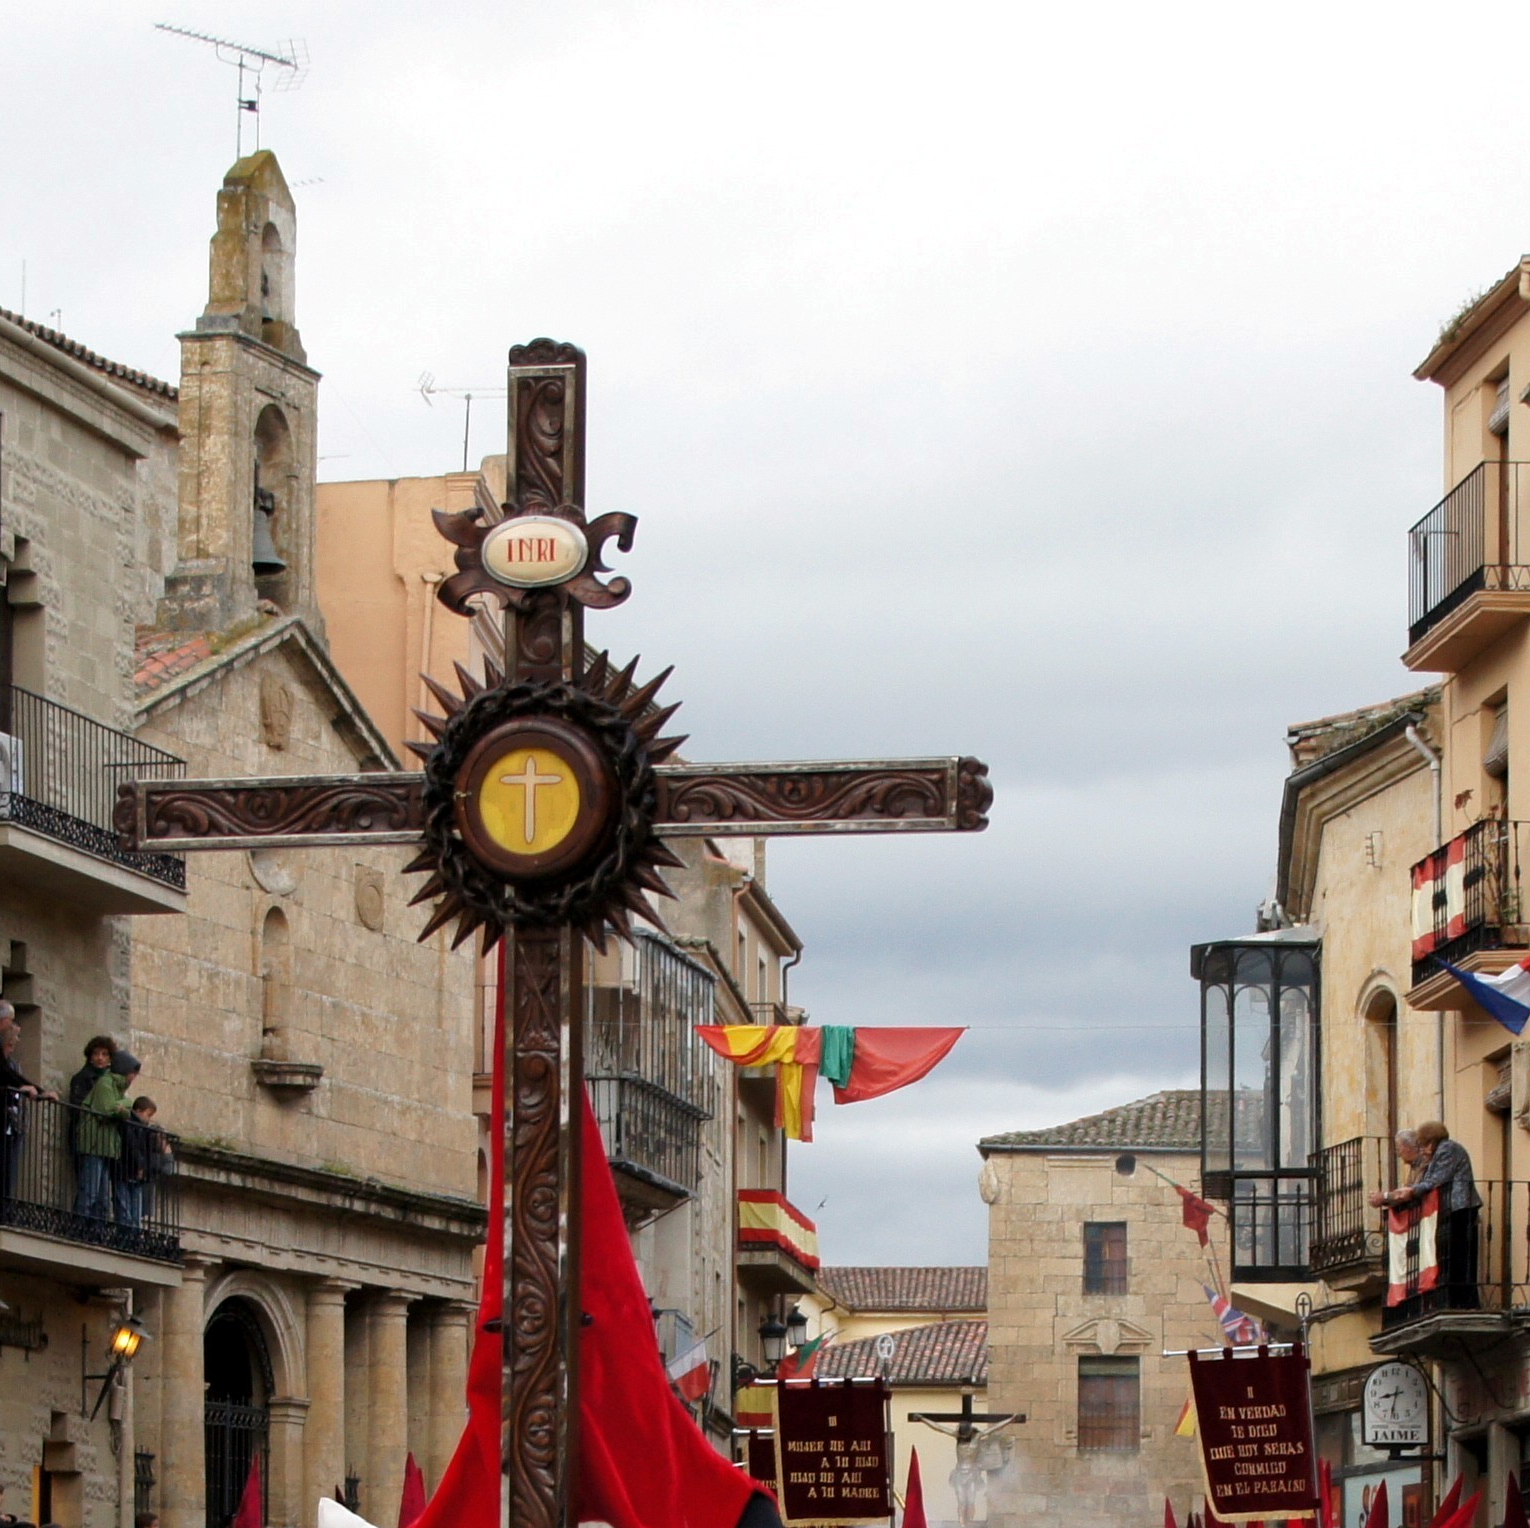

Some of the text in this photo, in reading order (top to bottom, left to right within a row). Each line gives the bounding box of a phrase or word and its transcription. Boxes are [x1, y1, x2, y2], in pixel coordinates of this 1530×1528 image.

[507, 538, 557, 563] INRI
[1246, 1386, 1254, 1399] II
[1219, 1404, 1287, 1420] EN VERDAD
[1231, 1423, 1278, 1439] TE DIGO
[1372, 1430, 1421, 1441] JAIME
[788, 1440, 824, 1452] MUJER
[1210, 1441, 1305, 1460] QUE HOY SERAS
[821, 1456, 879, 1468] A TU HIJO
[1234, 1461, 1287, 1476] CONMIGO
[790, 1472, 816, 1483] HIJO
[807, 1486, 880, 1498] A TU MADRE
[1216, 1484, 1233, 1497] EN
[1236, 1482, 1251, 1495] EL
